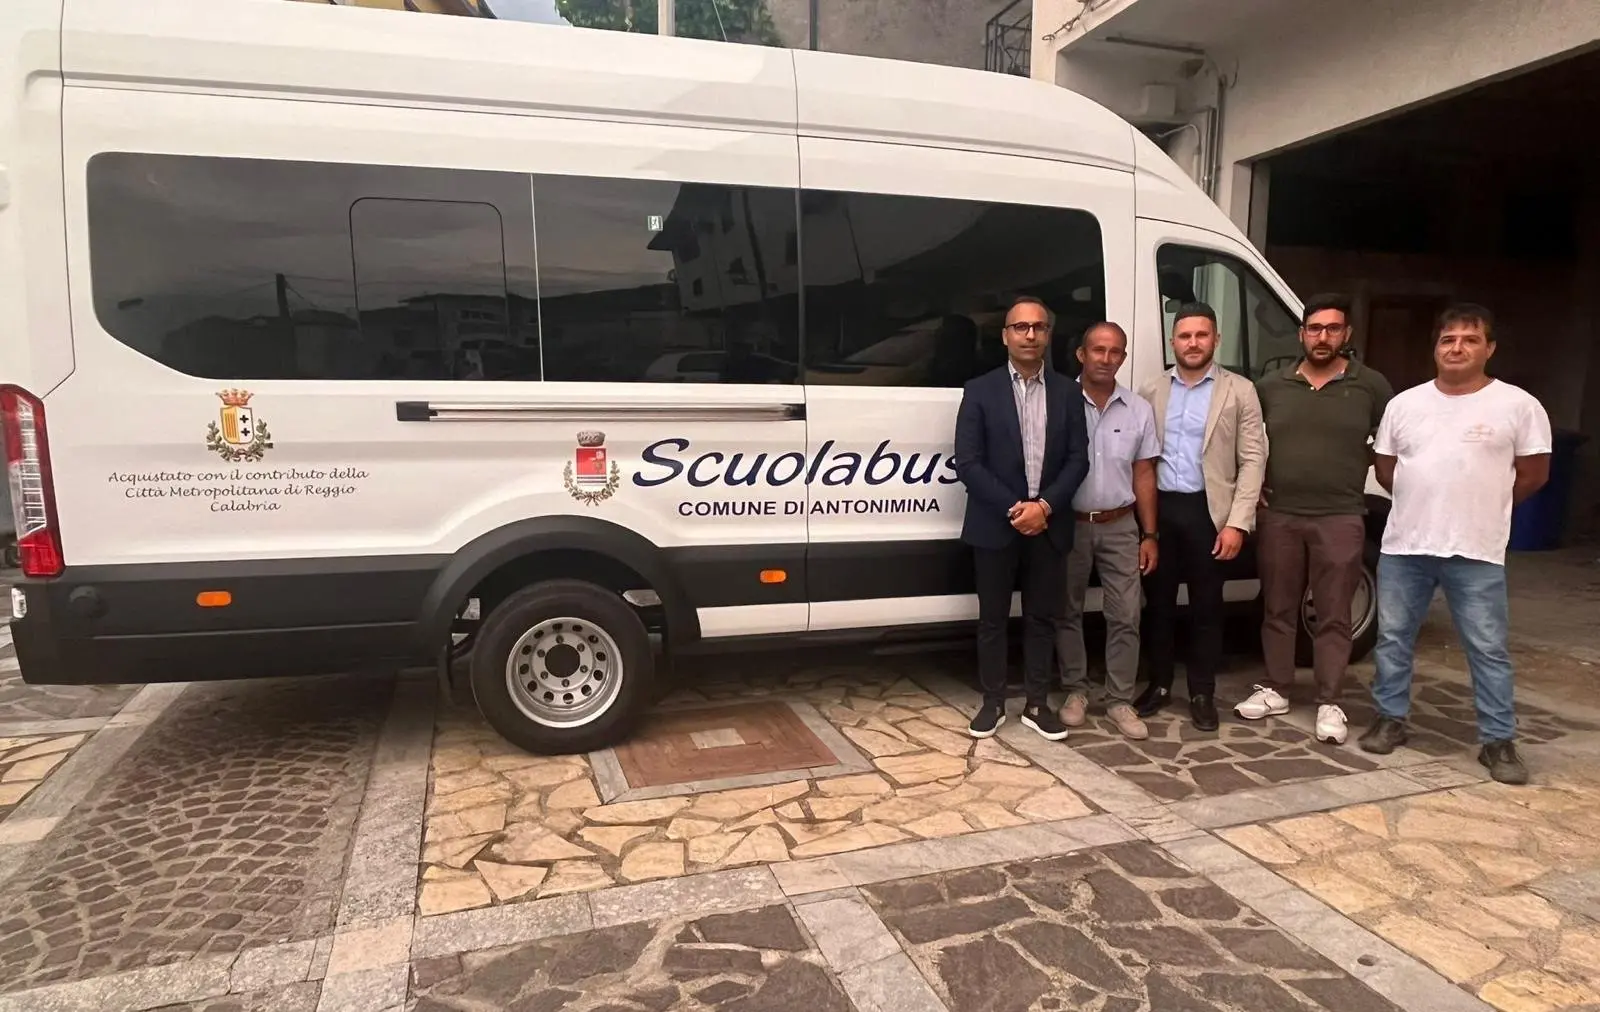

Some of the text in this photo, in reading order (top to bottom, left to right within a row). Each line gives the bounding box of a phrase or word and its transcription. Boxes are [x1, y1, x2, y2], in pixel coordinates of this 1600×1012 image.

[108, 467, 369, 485] Acquistato con il contributo della
[125, 484, 357, 499] Città Metropolitana di Reggio
[210, 500, 282, 513] Calabria
[678, 498, 941, 516] COMUNE DI ANTONIMINA
